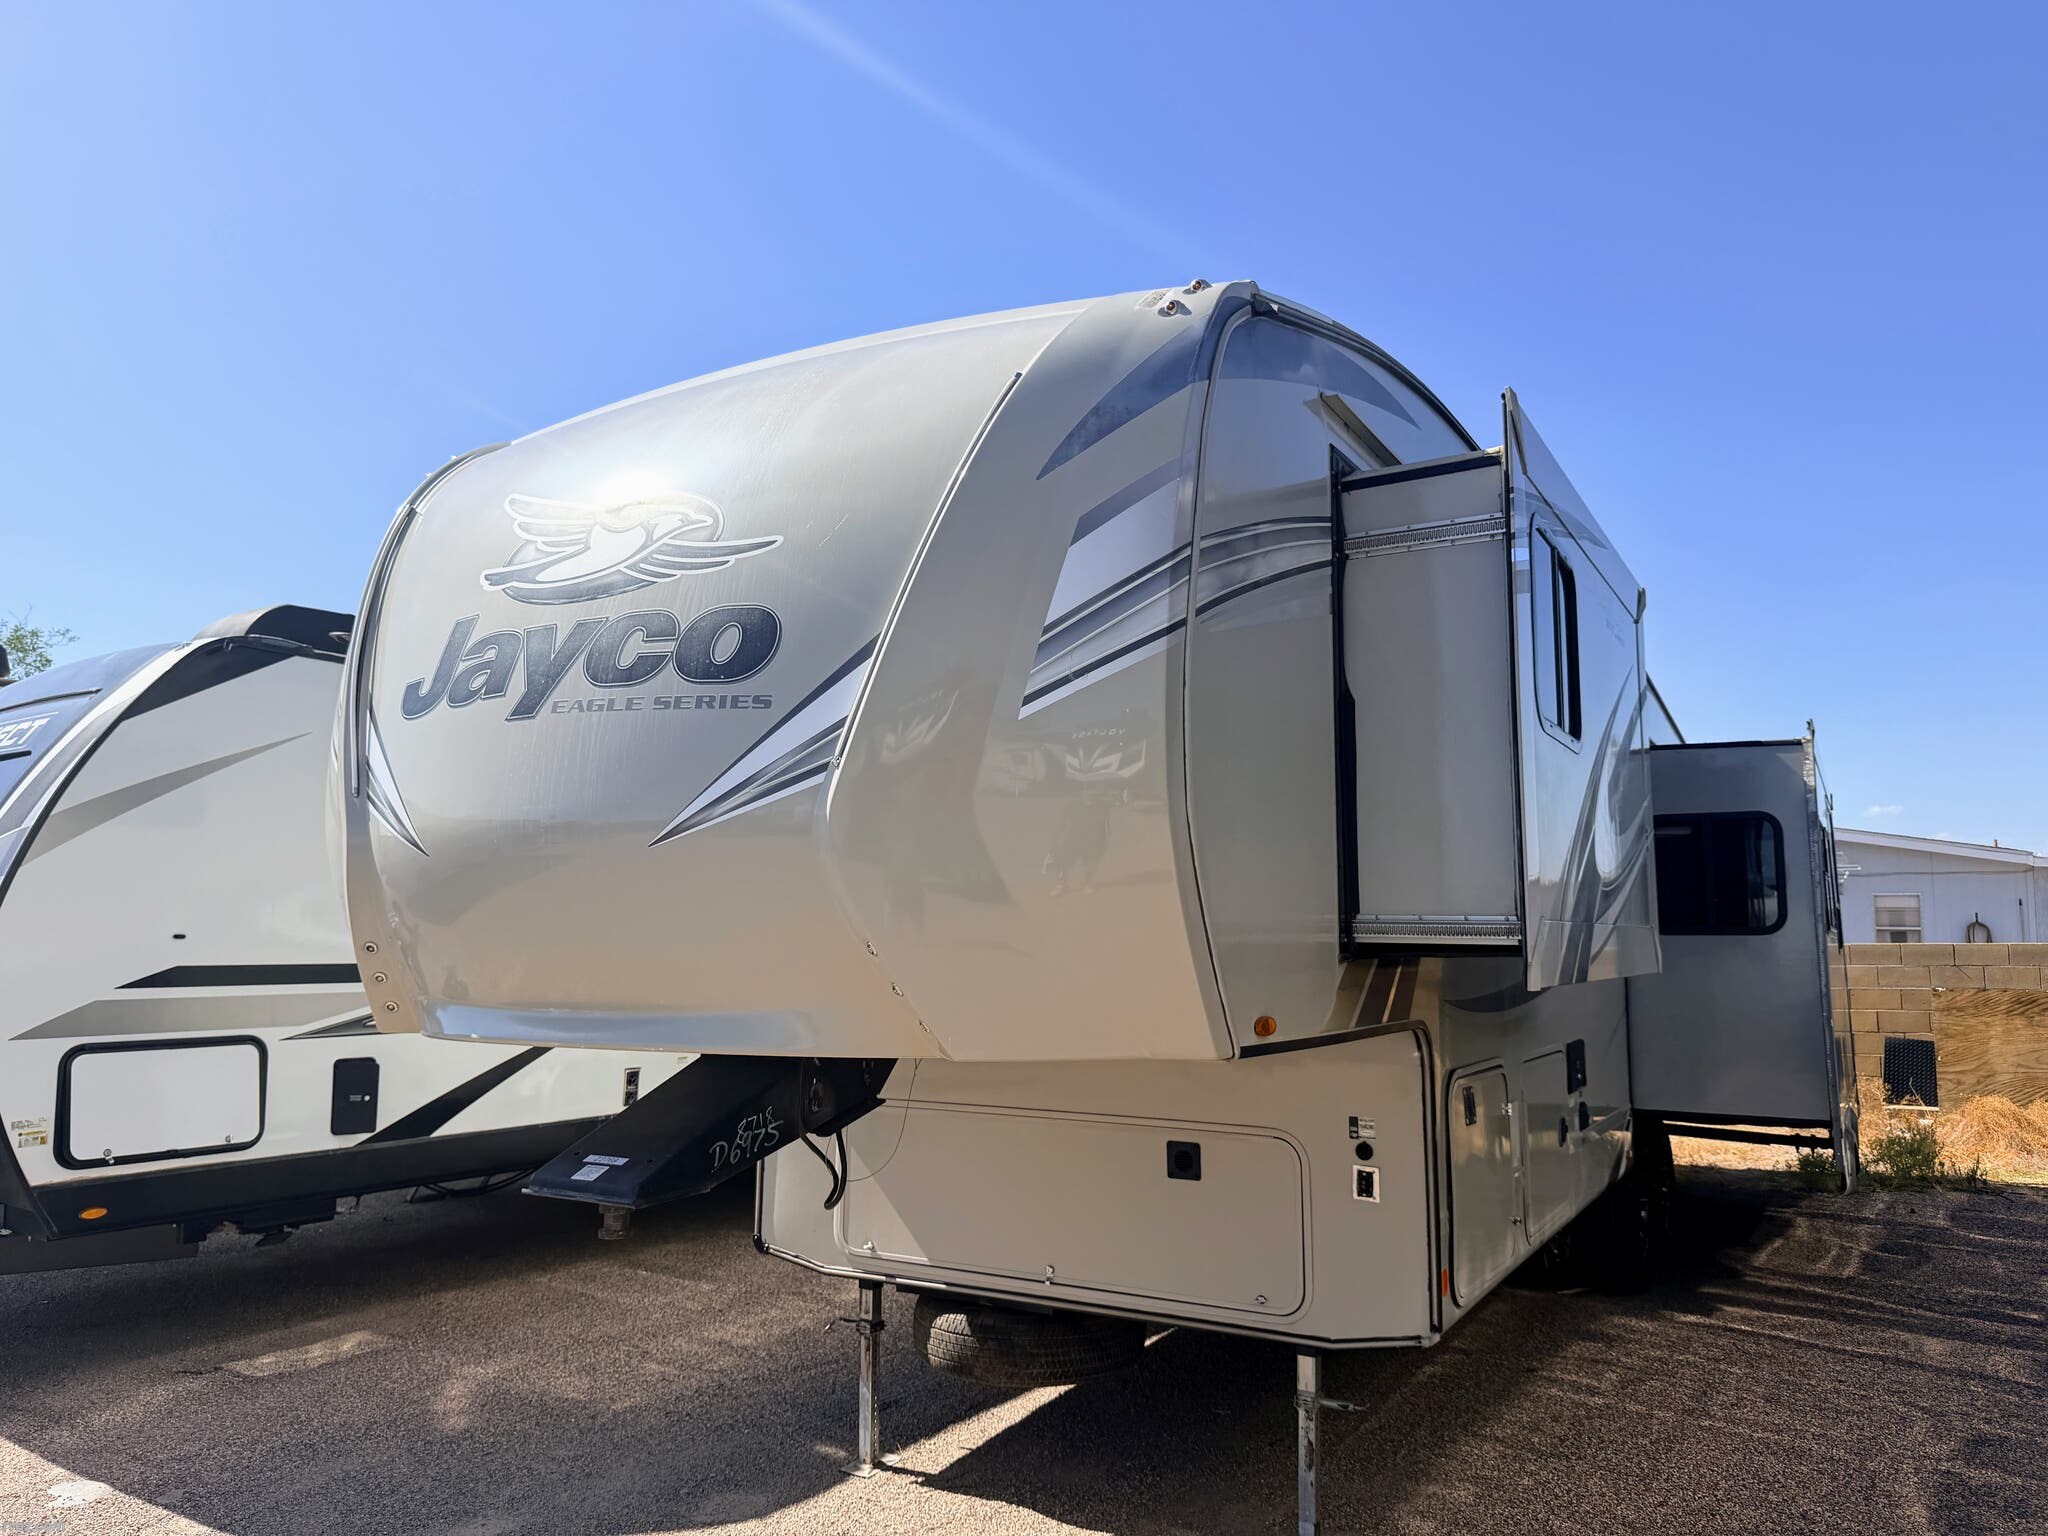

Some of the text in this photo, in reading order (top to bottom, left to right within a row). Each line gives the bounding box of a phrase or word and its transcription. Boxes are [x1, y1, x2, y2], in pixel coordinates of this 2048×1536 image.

[401, 603, 782, 722] Jayco
[551, 694, 773, 714] EAGLE SERIES
